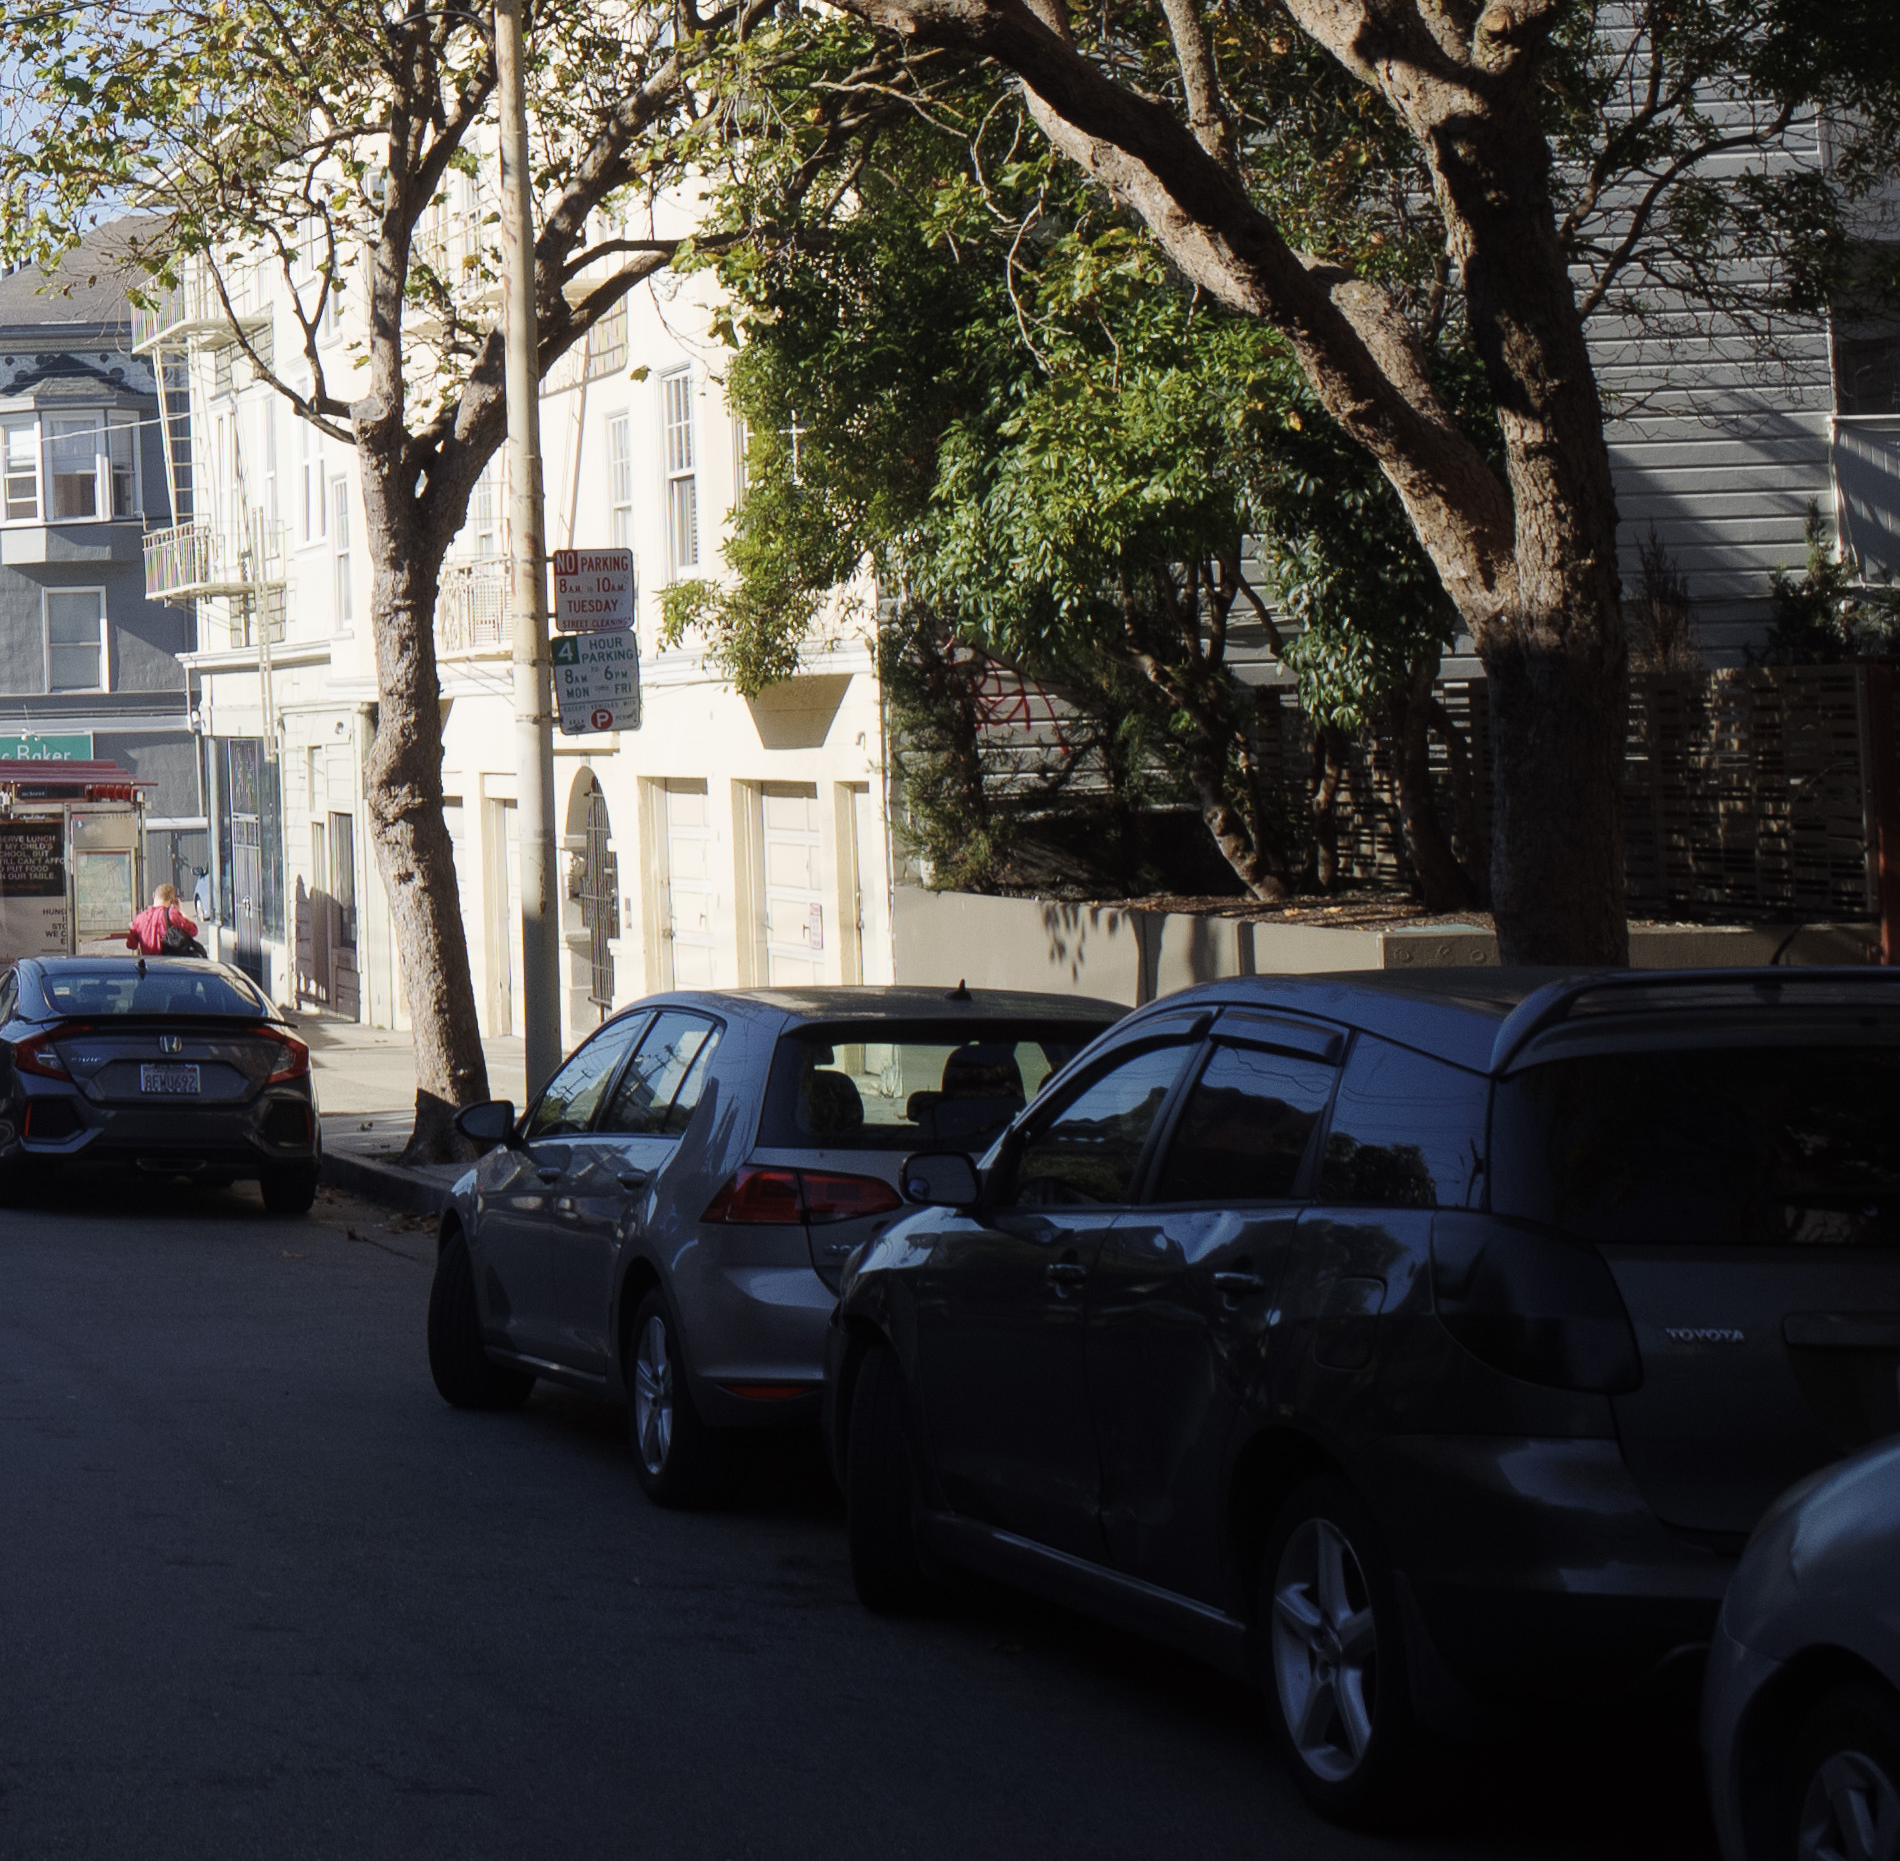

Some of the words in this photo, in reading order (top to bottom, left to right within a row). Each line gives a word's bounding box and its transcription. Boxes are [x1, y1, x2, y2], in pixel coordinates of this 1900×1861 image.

[556, 552, 575, 573] NO
[580, 556, 628, 572] PARKING
[567, 599, 618, 613] TUESDAY
[562, 620, 588, 628] STREET
[591, 618, 628, 628] CLEANING
[558, 641, 573, 661] 4
[589, 637, 623, 650] HOUR
[581, 648, 634, 664] PARKING
[564, 669, 587, 684] 8AM
[604, 665, 628, 680] 6PM
[566, 688, 590, 699] MON
[614, 683, 632, 694] FRI
[26, 835, 56, 843] LUNCH
[32, 849, 49, 857] BUT
[44, 857, 66, 865] AFFO
[6, 865, 23, 873] PUT
[1665, 1327, 1744, 1344] TOYOTA
